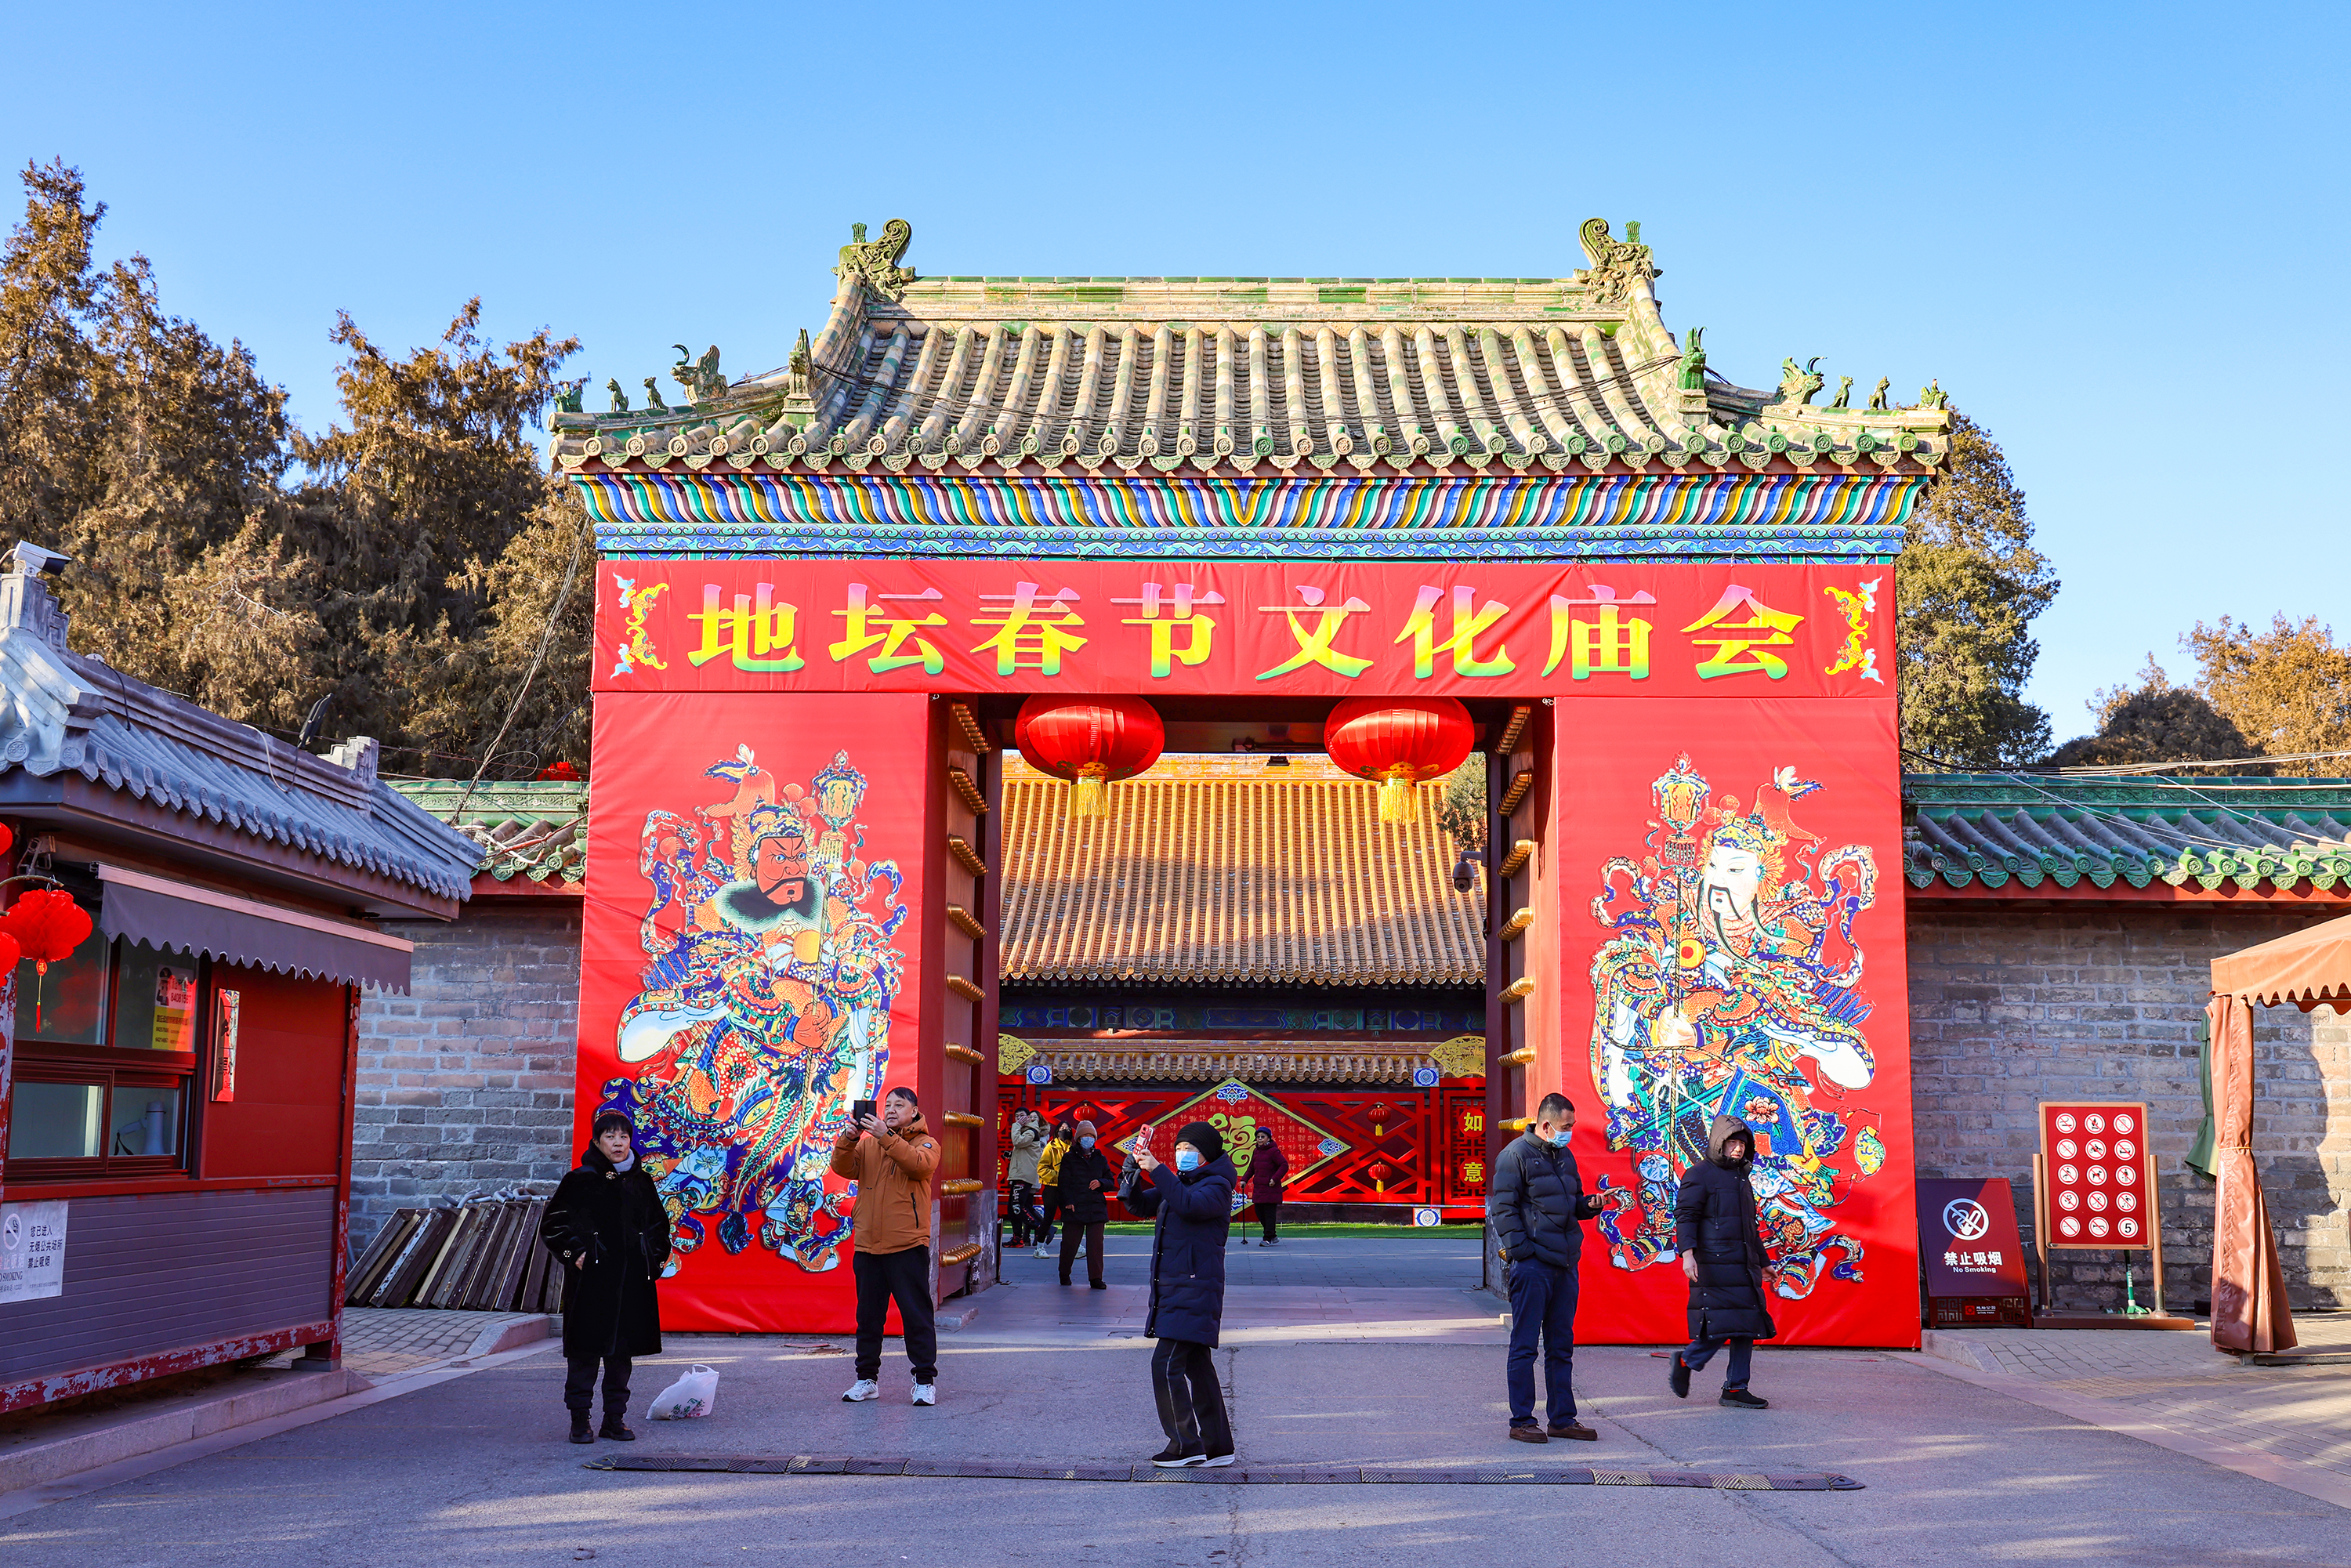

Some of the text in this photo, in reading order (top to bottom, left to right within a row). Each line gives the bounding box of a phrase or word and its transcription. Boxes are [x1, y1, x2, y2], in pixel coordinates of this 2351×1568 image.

[687, 581, 1806, 681] 地坛春节文化庙会
[1463, 1112, 1483, 1182] 如意
[30, 1225, 53, 1238] 您已进入
[2125, 1222, 2132, 1233] 5
[28, 1239, 63, 1253] 无烟公共场所
[27, 1255, 50, 1269] 禁止吸烟
[1943, 1251, 2003, 1266] 禁止吸烟
[3, 1271, 23, 1282] SMOKING
